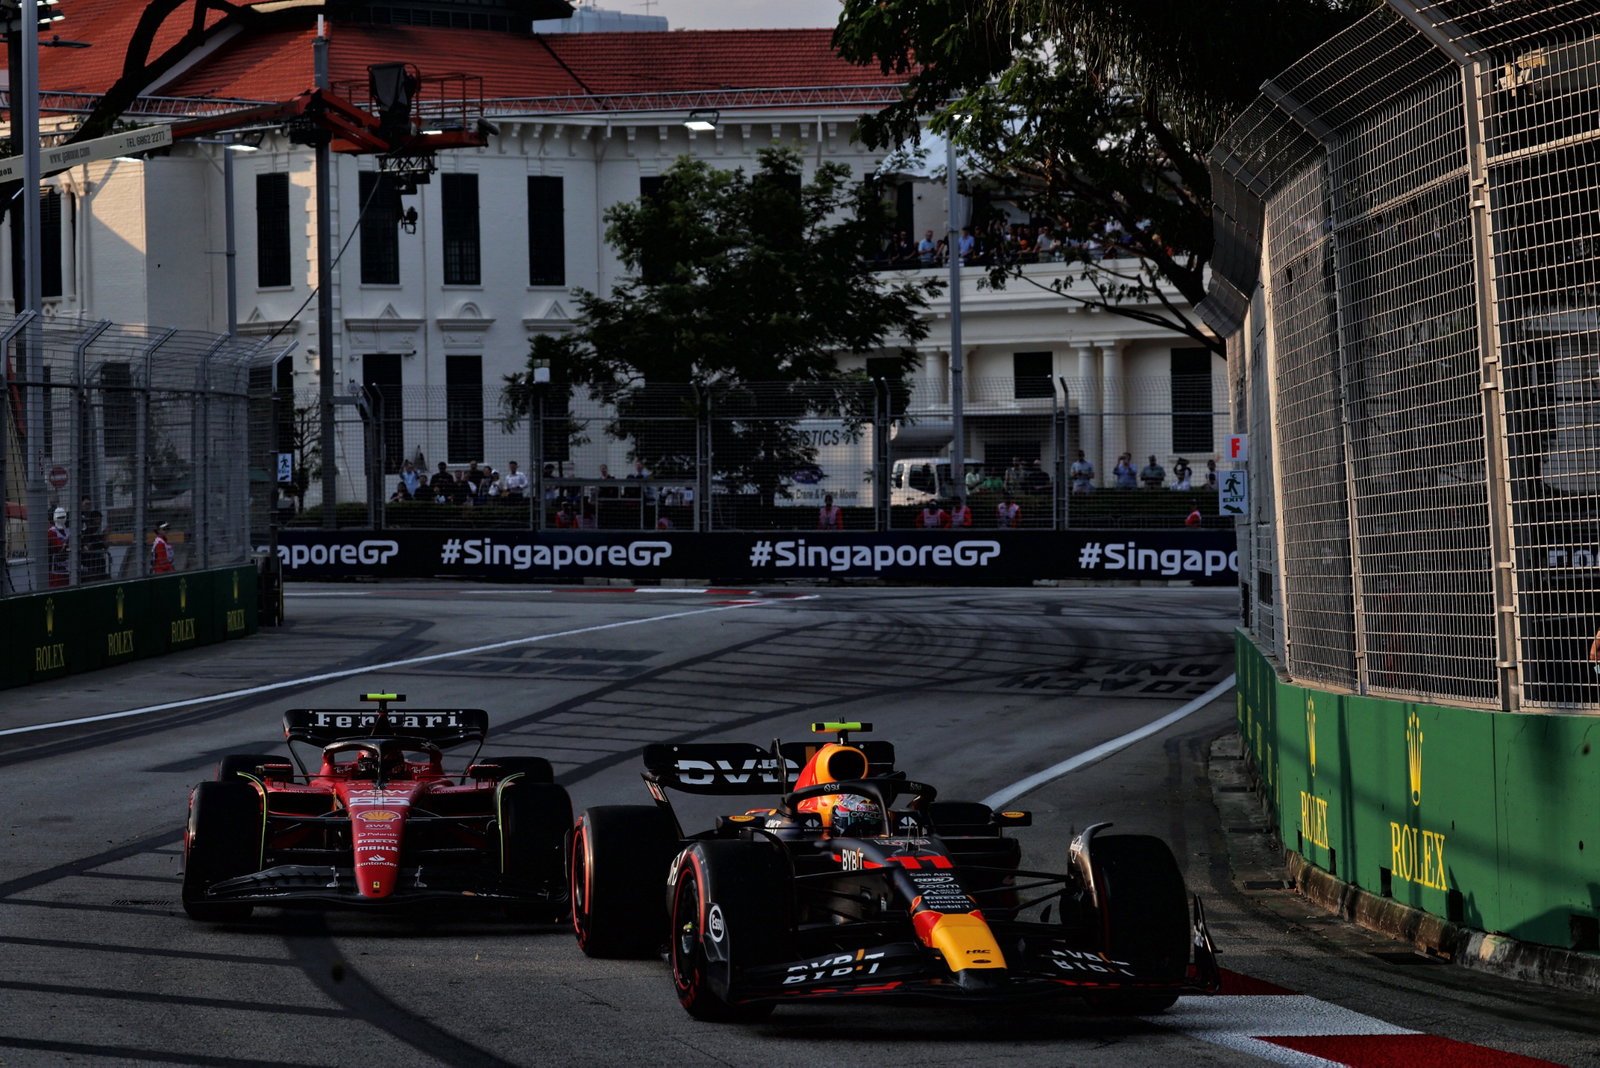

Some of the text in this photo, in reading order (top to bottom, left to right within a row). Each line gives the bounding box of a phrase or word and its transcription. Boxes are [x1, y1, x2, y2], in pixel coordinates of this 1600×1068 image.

[1231, 437, 1241, 459] F
[440, 537, 673, 570] #SingaporeGP
[749, 538, 1001, 572] #SingaporeGP
[171, 618, 196, 643] ROLEX
[226, 609, 245, 632] ROLEX
[107, 630, 134, 656] ROLEX
[35, 643, 65, 672] ROLEX
[1300, 790, 1330, 850] ROLEX
[357, 845, 398, 853] MAHLE
[842, 848, 864, 871] BYBIT
[1390, 821, 1448, 891] ROLEX
[884, 855, 954, 870] 11
